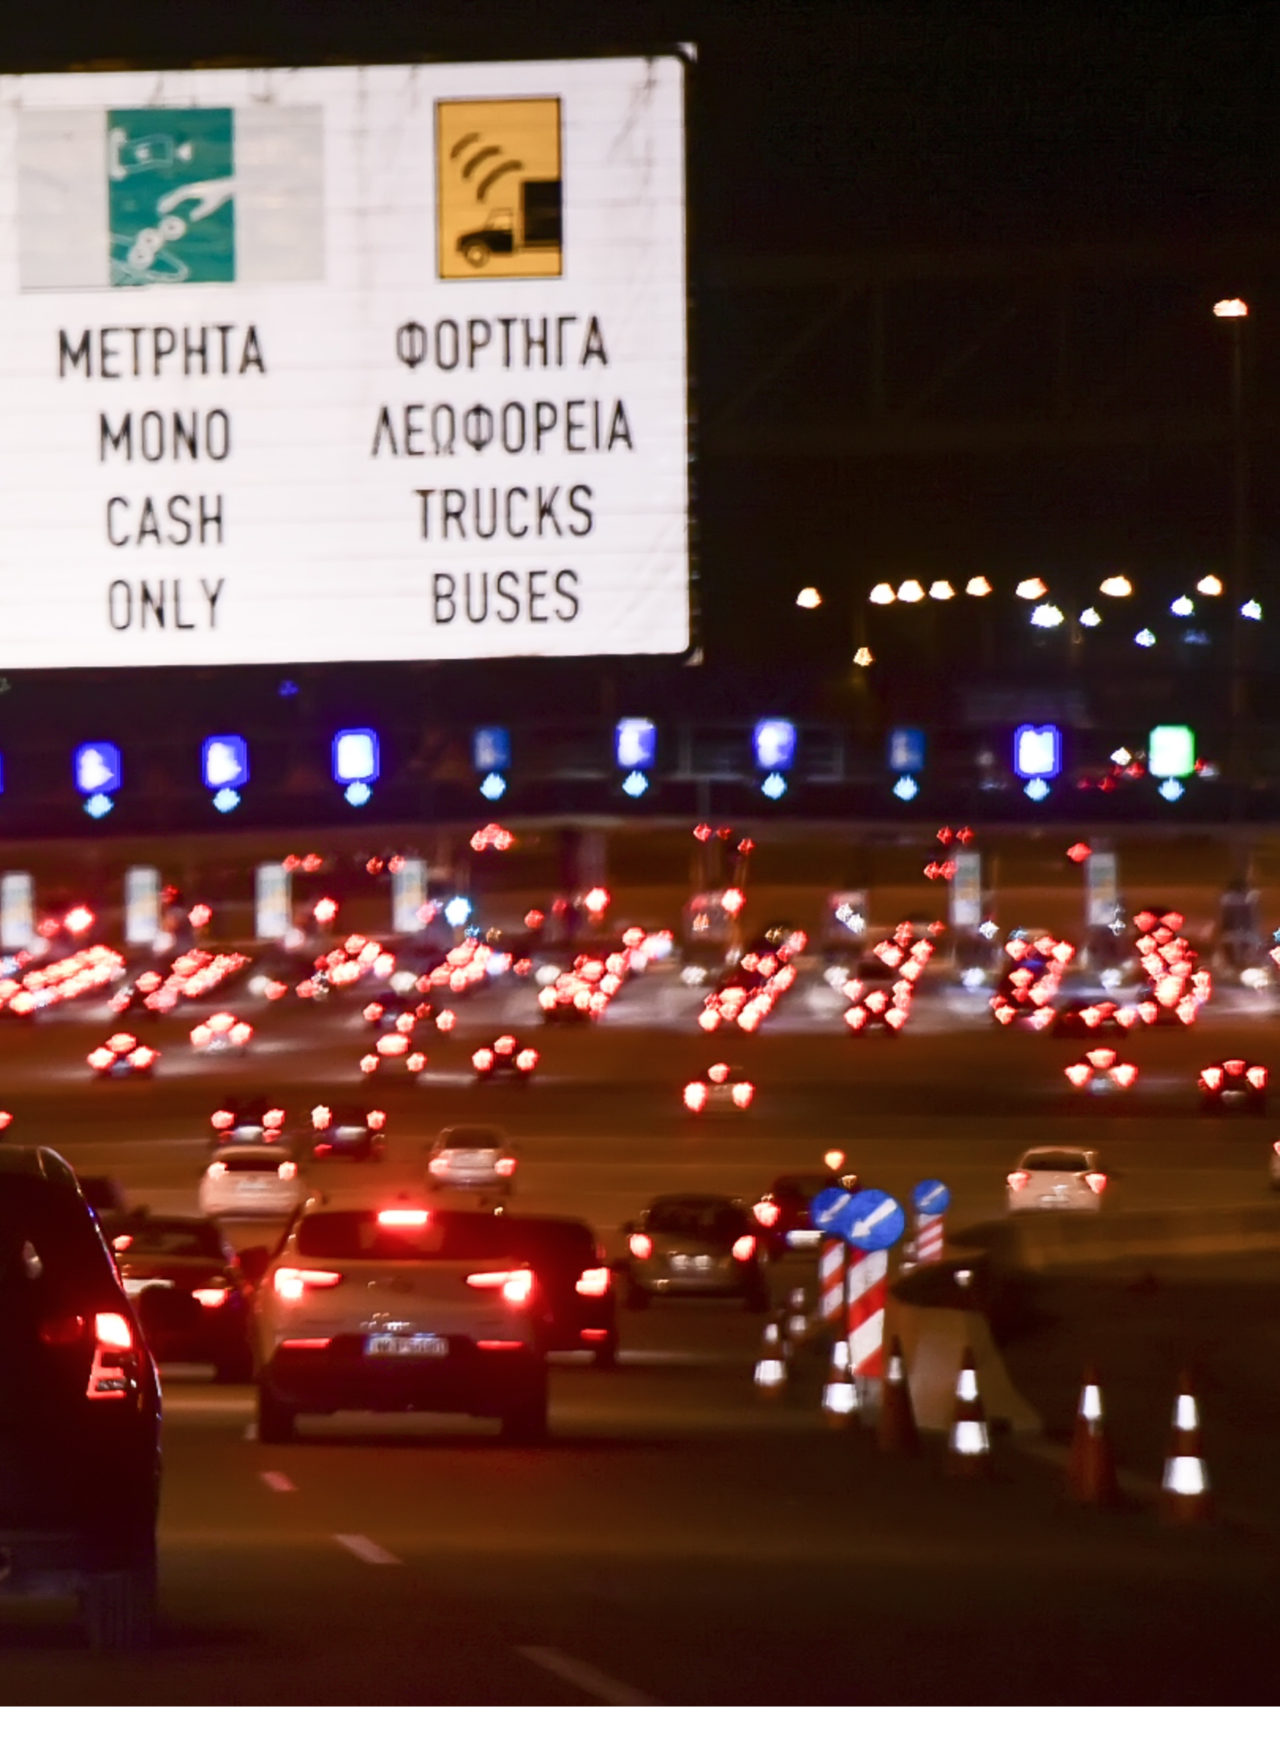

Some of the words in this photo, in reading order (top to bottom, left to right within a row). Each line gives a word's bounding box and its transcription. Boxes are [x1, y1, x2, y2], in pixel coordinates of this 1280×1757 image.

[57, 323, 267, 380] ΜΕΤΡΗΤΑ
[395, 314, 610, 373] ΦΟΡΤΗΓΑ
[99, 407, 232, 463] ΜΟΝΟ
[371, 398, 634, 458] ΛΕΩΦΟΡΕΙΑ
[106, 493, 224, 548] CASH
[413, 483, 594, 541] TRUCKS
[108, 578, 225, 632] ONLY
[431, 568, 580, 626] BUSES
